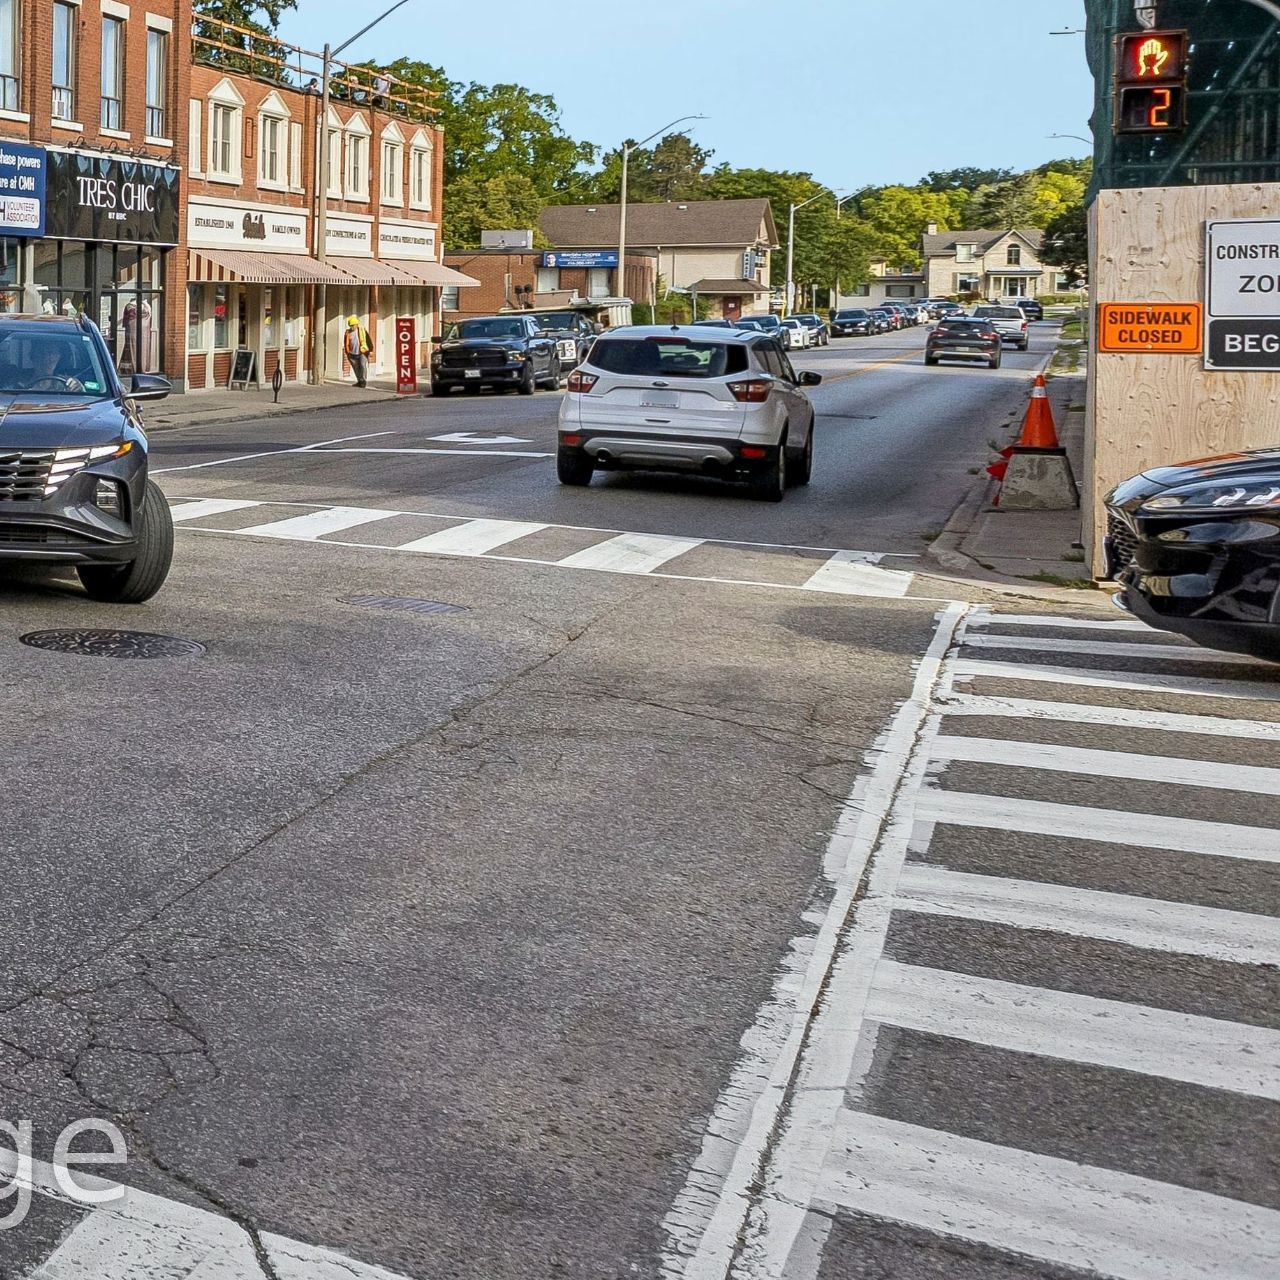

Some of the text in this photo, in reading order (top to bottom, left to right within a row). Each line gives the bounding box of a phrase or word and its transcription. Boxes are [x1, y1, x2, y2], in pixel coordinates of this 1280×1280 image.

[1150, 89, 1170, 126] 2
[17, 156, 41, 170] powers
[10, 176, 17, 189] at
[18, 176, 35, 191] CMH
[76, 172, 155, 212] TRÈS CHIC
[6, 201, 36, 212] VOLUNTEER
[6, 213, 39, 224] ASSOCIATION
[195, 217, 225, 229] ESTABLISHED
[287, 225, 301, 235] OWNED
[1216, 244, 1280, 260] CONSTR
[1238, 274, 1280, 293] ZO
[1108, 311, 1192, 326] SIDEWALK
[1118, 329, 1182, 344] CLOSED
[1224, 334, 1280, 354] BEG
[399, 331, 411, 378] OPEN
